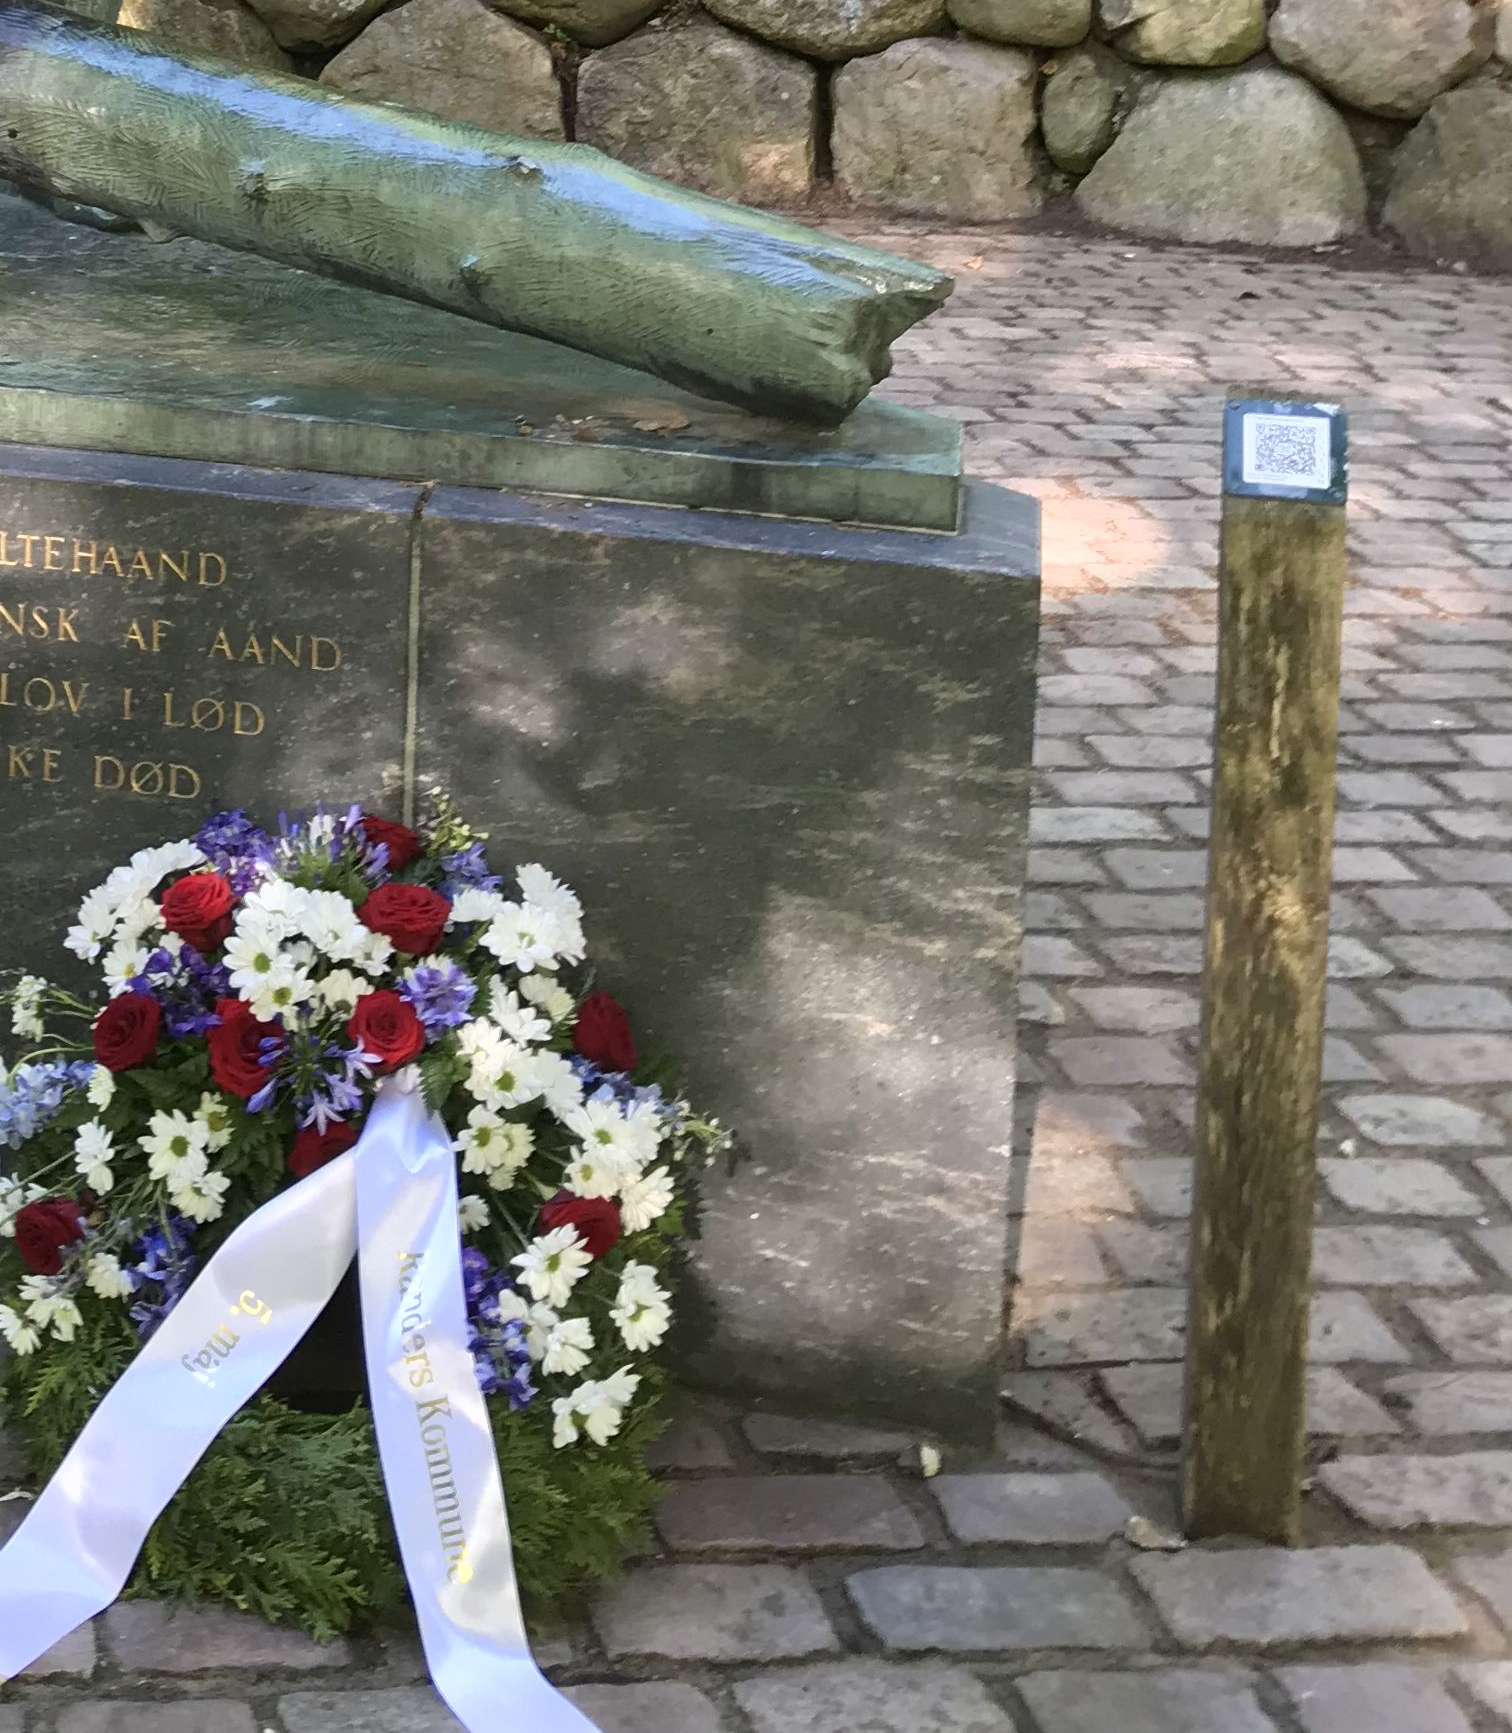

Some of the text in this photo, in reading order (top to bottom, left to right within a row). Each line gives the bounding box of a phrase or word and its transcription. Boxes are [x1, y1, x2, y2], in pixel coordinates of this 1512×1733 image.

[119, 618, 175, 653] AF
[207, 626, 343, 672] AAND
[121, 687, 134, 721] I
[163, 691, 266, 737] LØD
[93, 754, 202, 799] DØD
[229, 1289, 273, 1325] 5.
